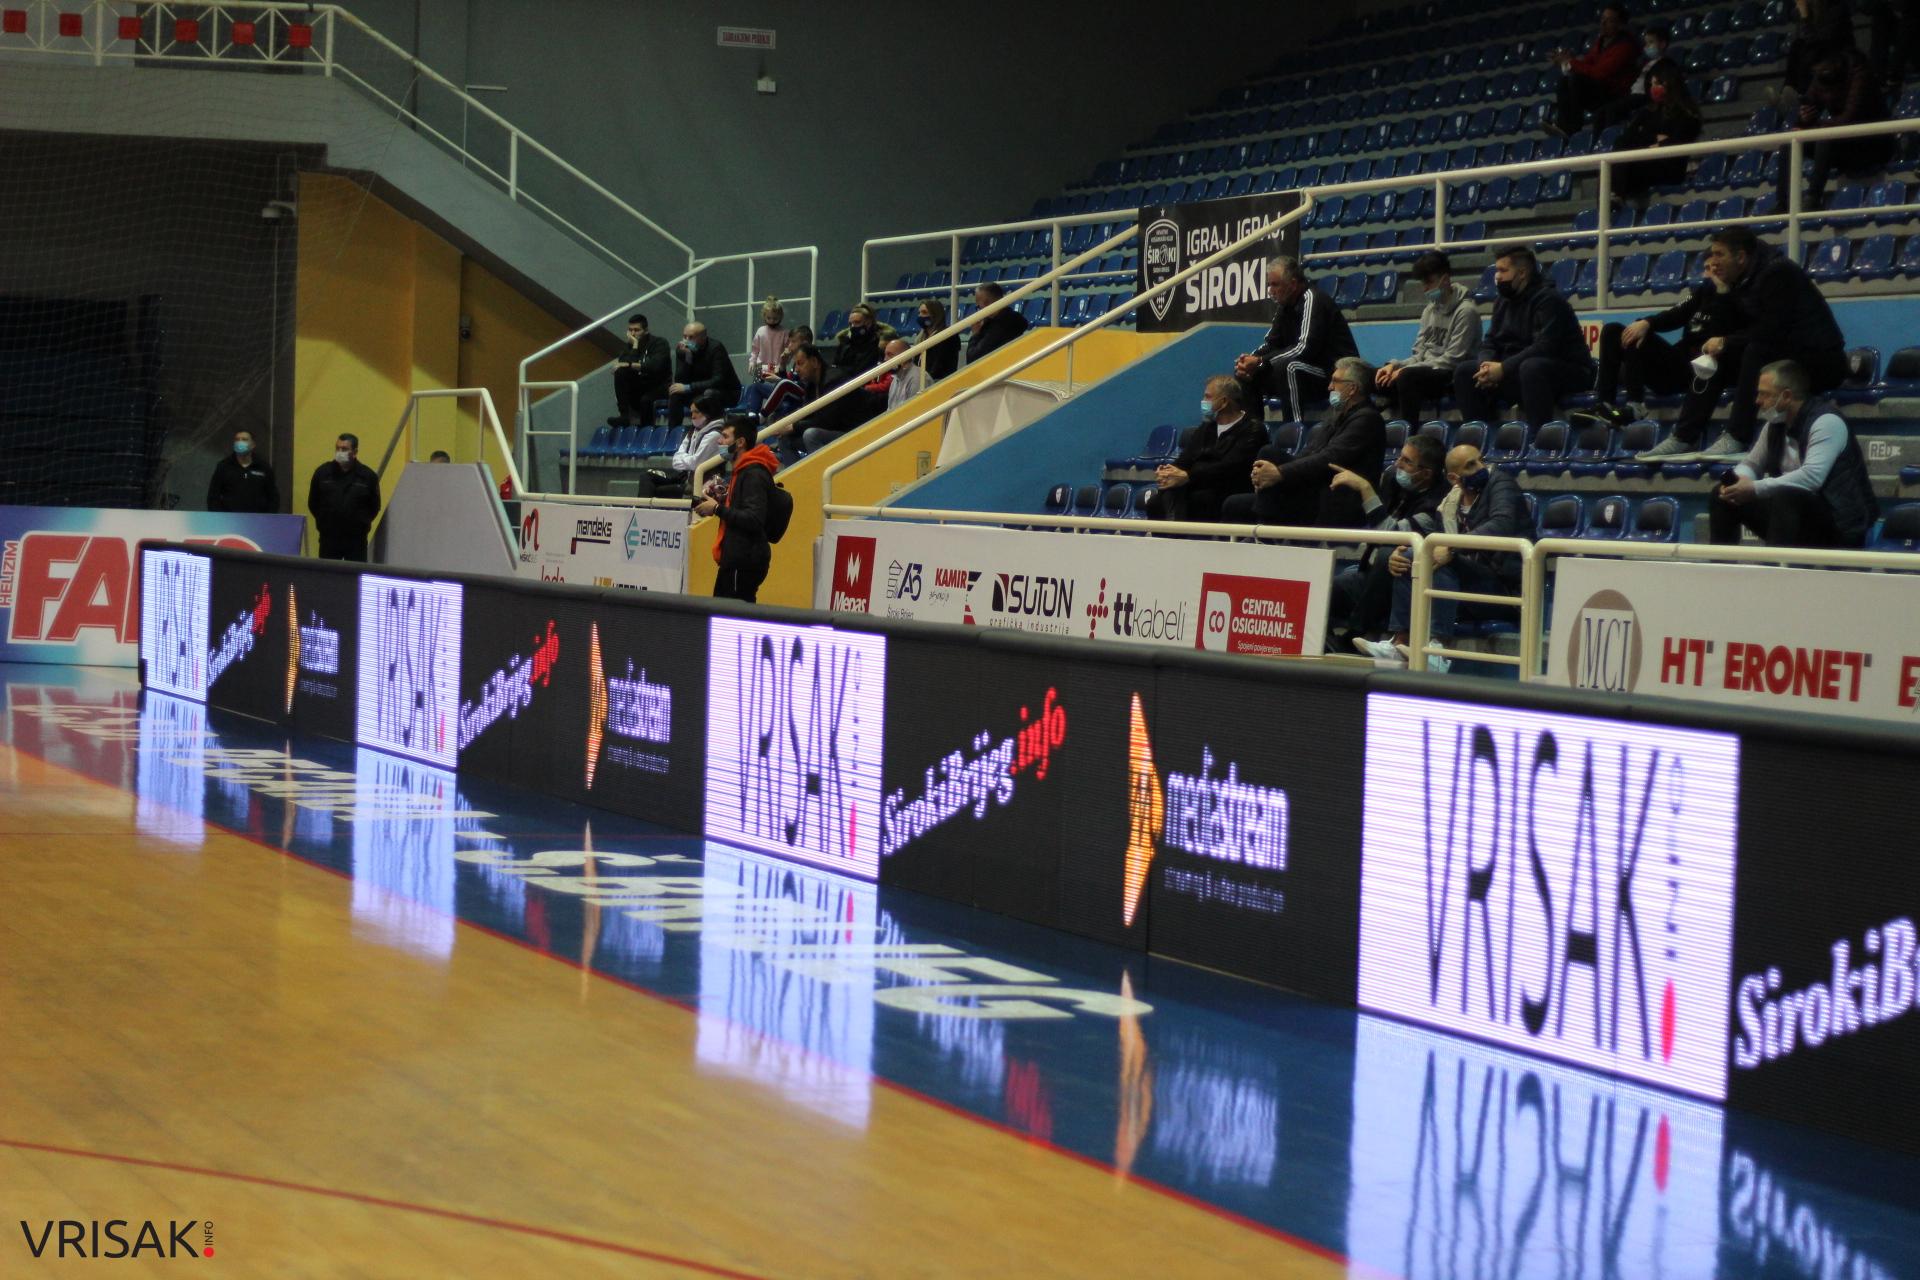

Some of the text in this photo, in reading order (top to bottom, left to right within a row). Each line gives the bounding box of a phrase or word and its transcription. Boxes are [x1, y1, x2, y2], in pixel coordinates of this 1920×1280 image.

[577, 517, 612, 537] mandeks
[641, 529, 681, 549] EMERUS
[0, 541, 19, 606] HELIZIM
[935, 568, 968, 589] KAMIR
[1010, 575, 1074, 619] SUTON
[1241, 598, 1286, 619] CENTRAL
[989, 618, 1070, 635] grafička industrija
[1232, 616, 1293, 640] OSIGURANJE
[1579, 617, 1632, 691] MCI
[1660, 637, 1866, 702] HT ERONET
[738, 632, 851, 860] VRISAK
[1423, 719, 1661, 1063] VRISAK
